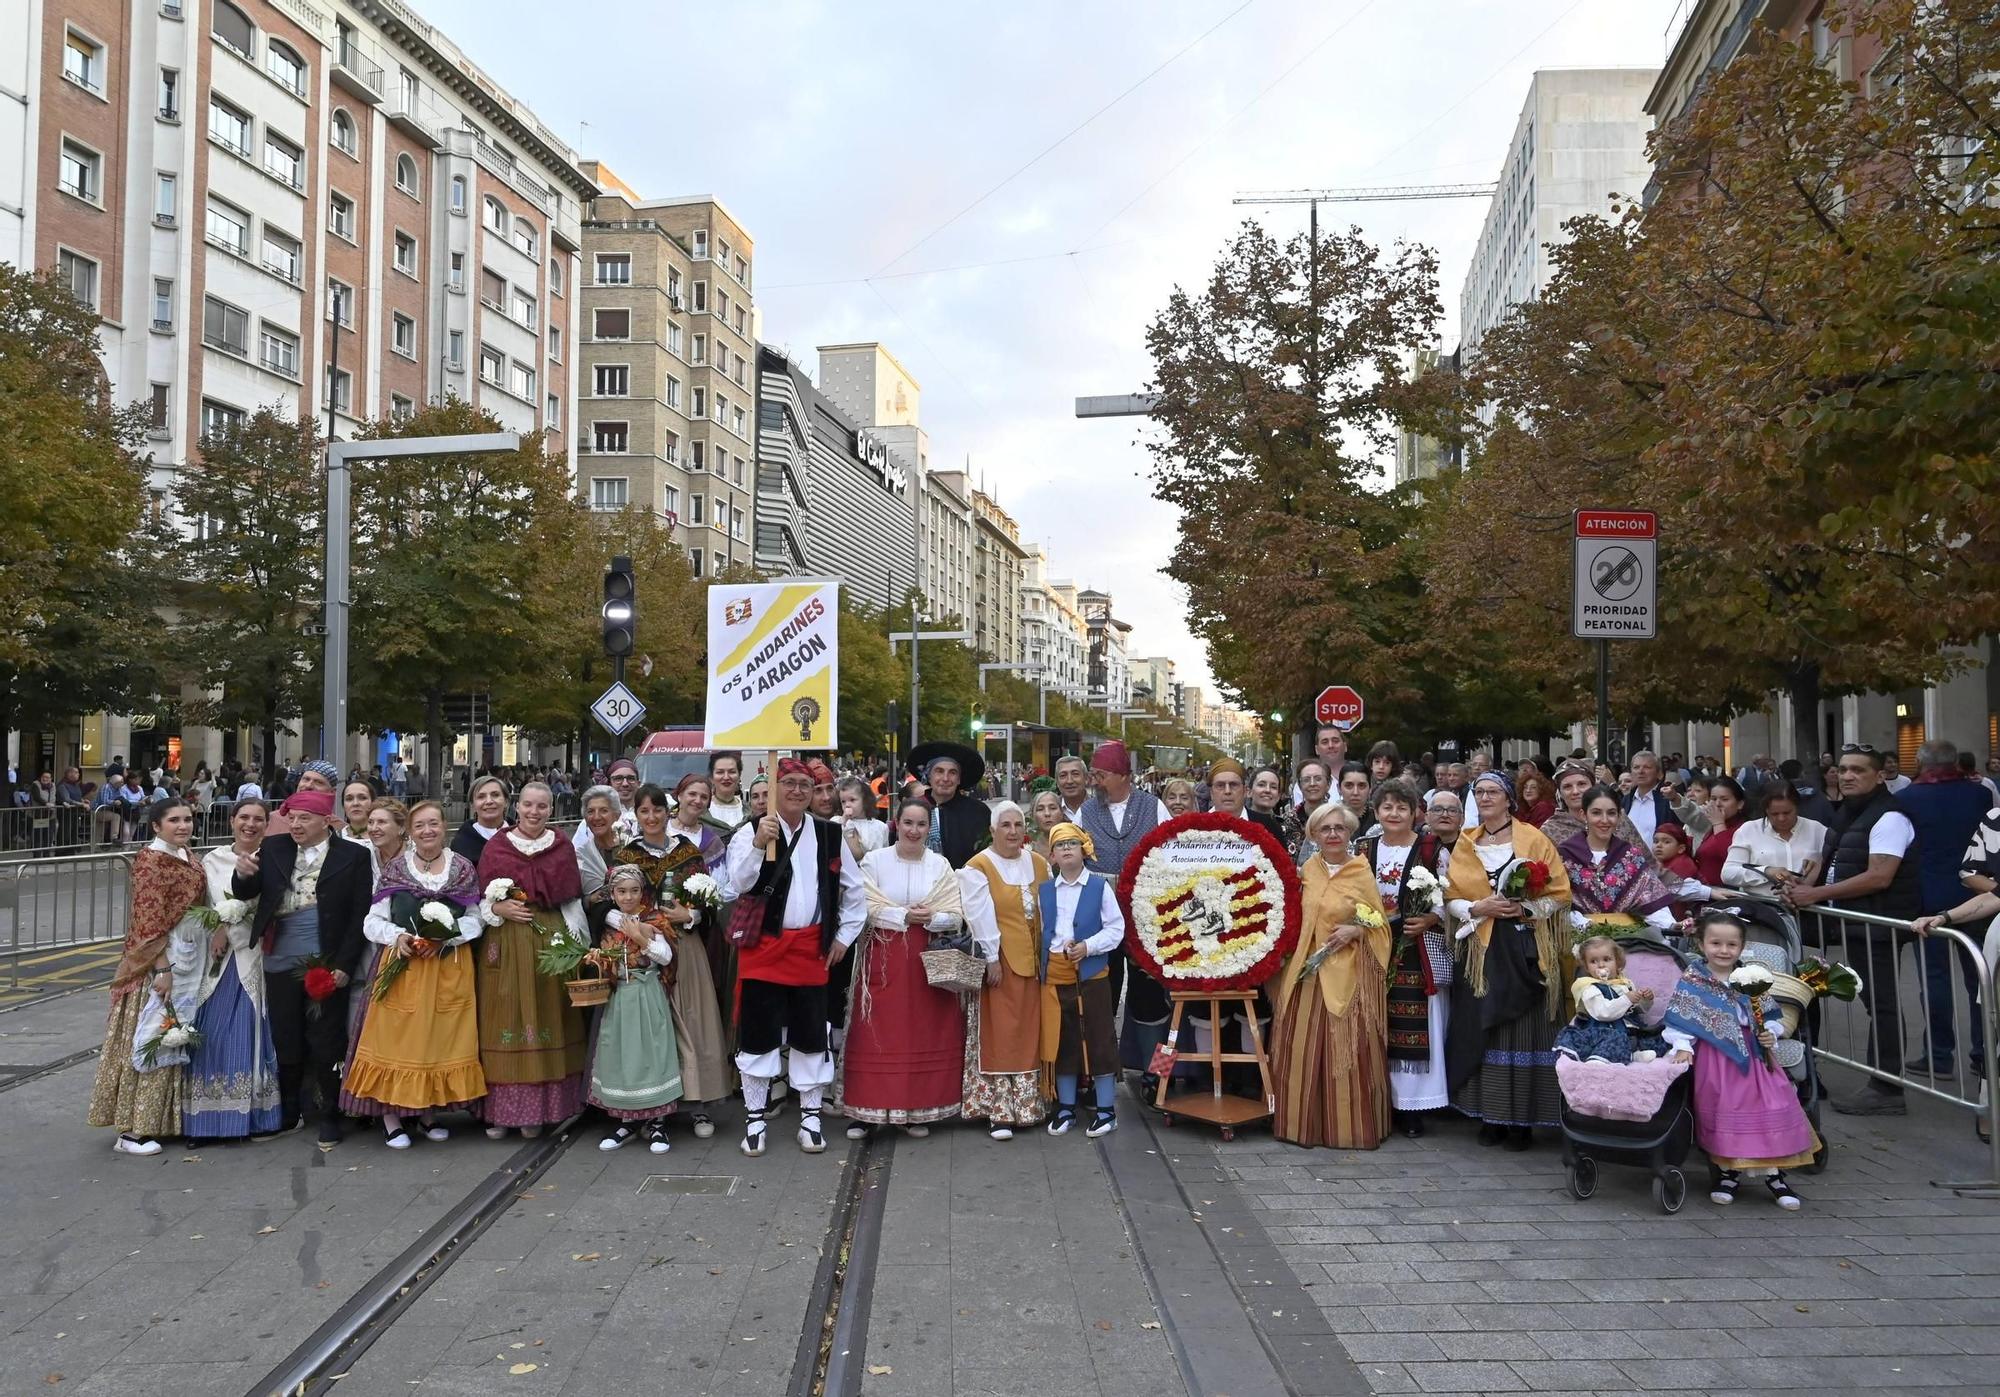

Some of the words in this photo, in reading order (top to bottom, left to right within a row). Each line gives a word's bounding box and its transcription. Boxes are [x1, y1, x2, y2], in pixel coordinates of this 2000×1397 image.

[857, 429, 866, 461] El
[1585, 519, 1647, 530] ATENCIÓN
[1584, 605, 1648, 615] PRIORIDAD
[1585, 620, 1647, 630] PEATONAL
[721, 673, 742, 694] OS
[746, 597, 825, 677] ANDARINES
[606, 699, 630, 717] 30
[1320, 703, 1358, 715] STOP
[1173, 840, 1214, 850] Andarines
